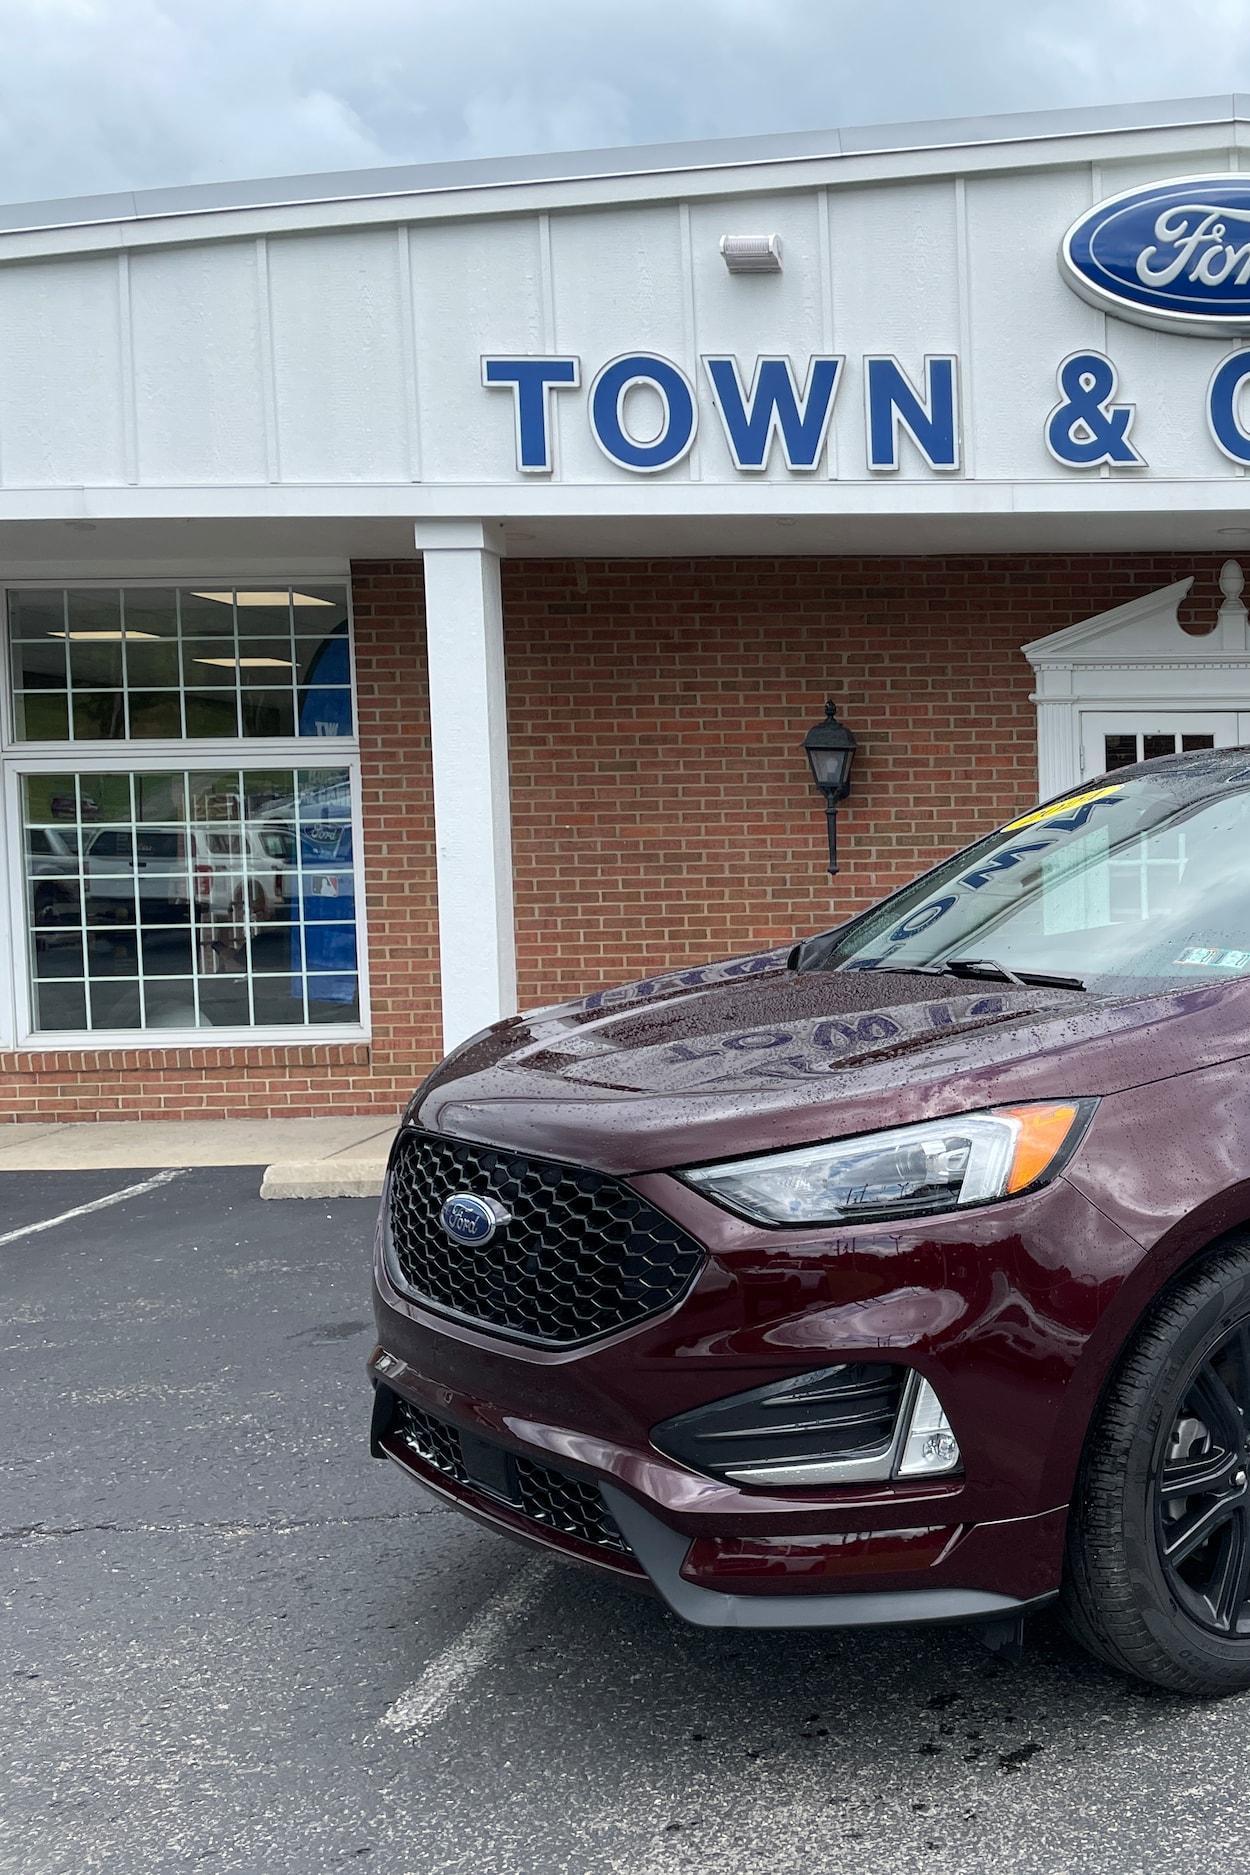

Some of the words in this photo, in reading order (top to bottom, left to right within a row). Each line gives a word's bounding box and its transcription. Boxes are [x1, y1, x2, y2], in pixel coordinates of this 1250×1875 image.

[481, 351, 960, 473] TOWN
[1044, 350, 1147, 469] &
[449, 1203, 480, 1235] Ford
